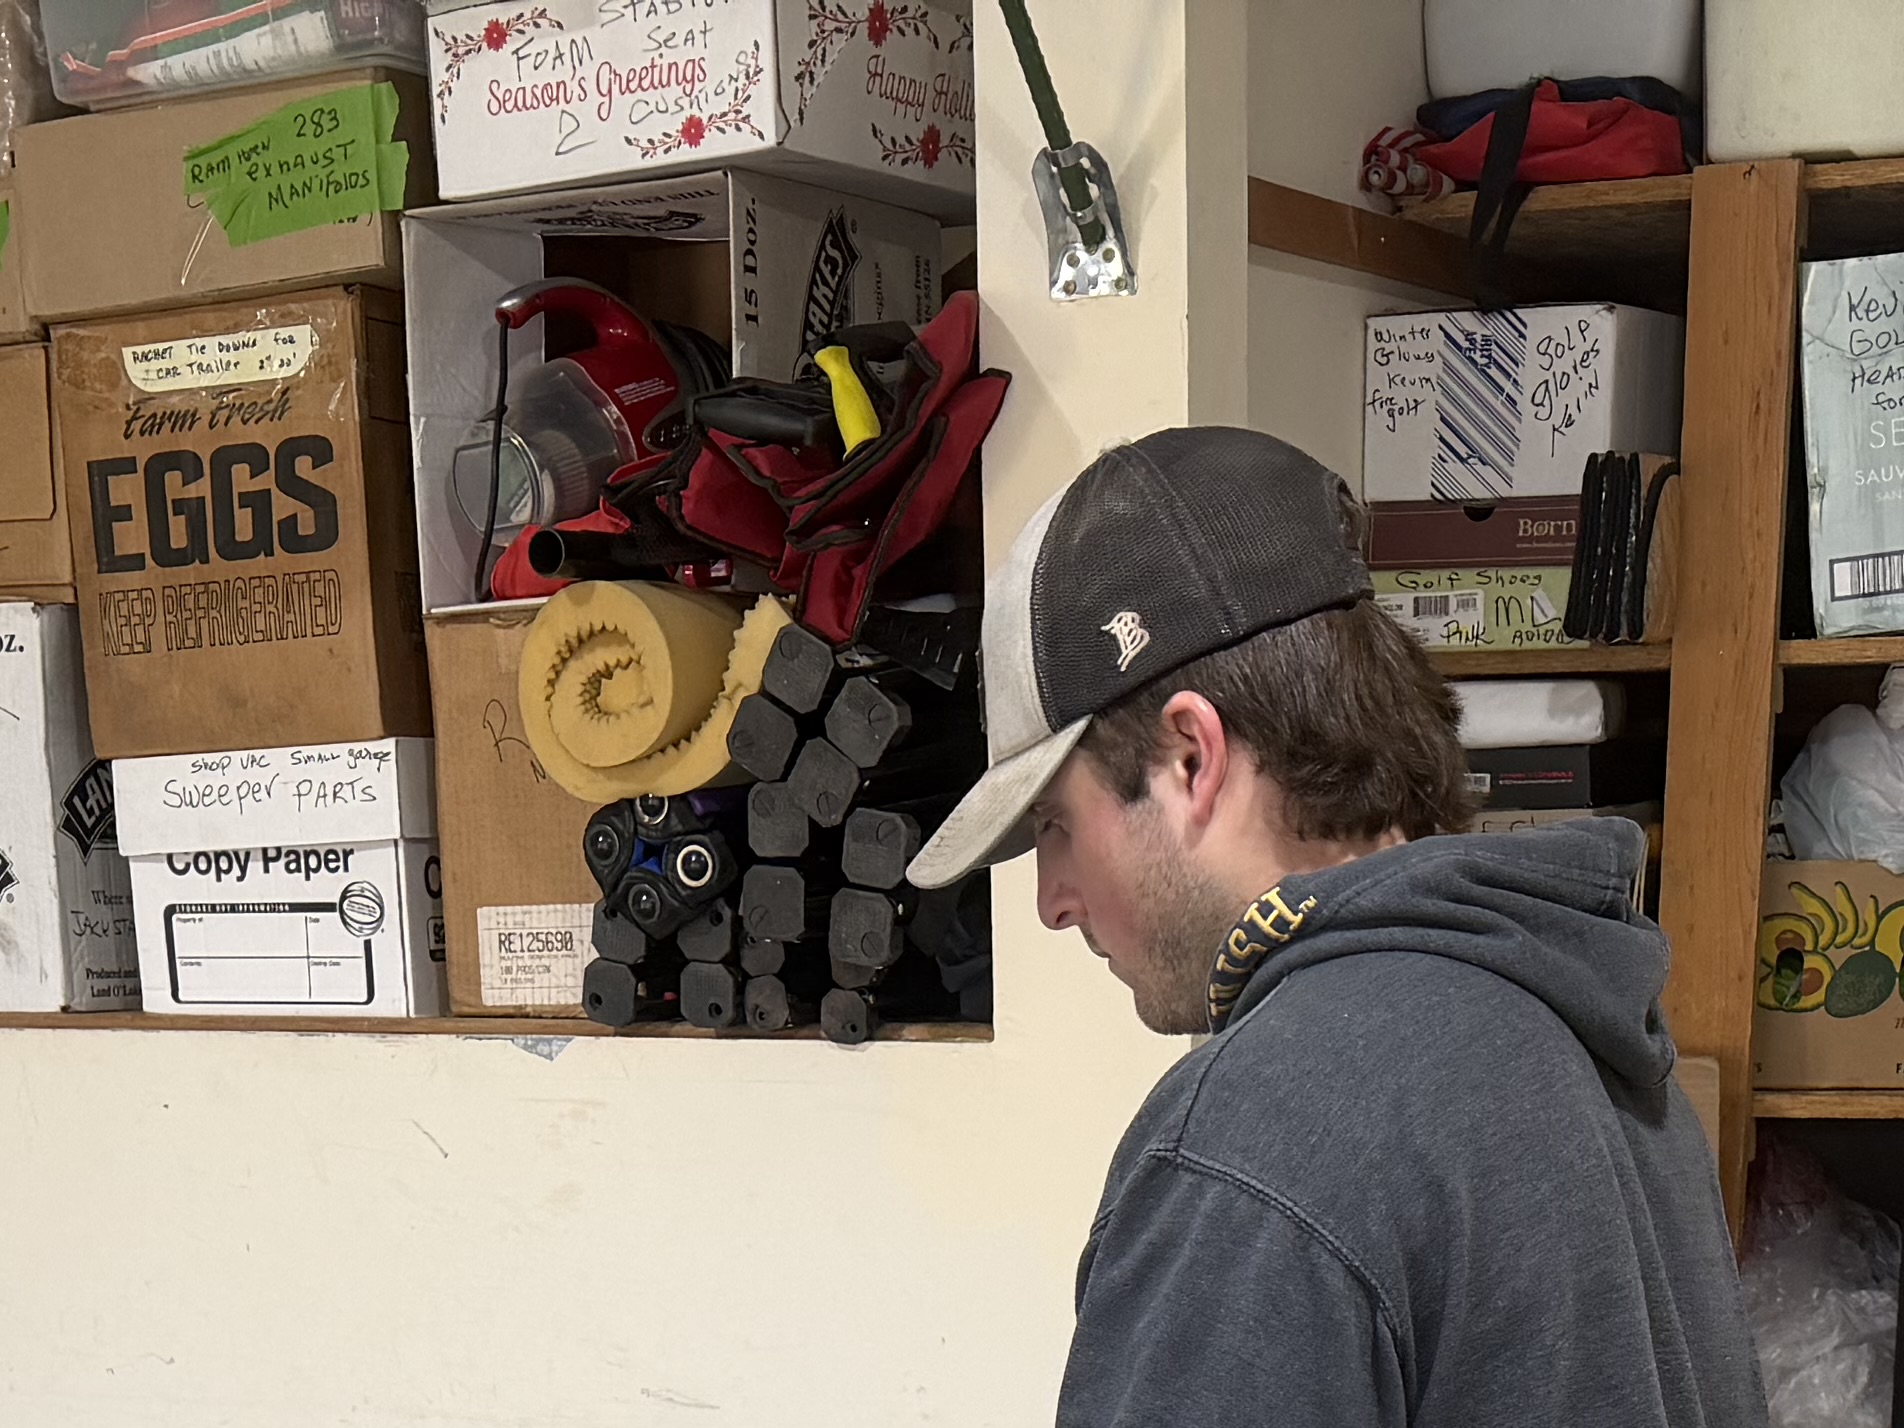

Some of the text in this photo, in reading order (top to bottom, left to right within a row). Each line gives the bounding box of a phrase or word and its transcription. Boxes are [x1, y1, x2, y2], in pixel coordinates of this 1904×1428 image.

[487, 53, 708, 121] Season's Greetings
[866, 54, 928, 122] Happy
[293, 107, 340, 138] 283
[745, 288, 760, 328] 15
[122, 385, 292, 440] Farm Fresh
[87, 434, 341, 574] EGGS
[1396, 569, 1543, 592] Golf Shoes
[99, 568, 343, 657] KEEP REFRIGERATED
[166, 847, 354, 882] Copy Paper
[86, 967, 122, 981] Produced
[91, 984, 112, 998] Land
